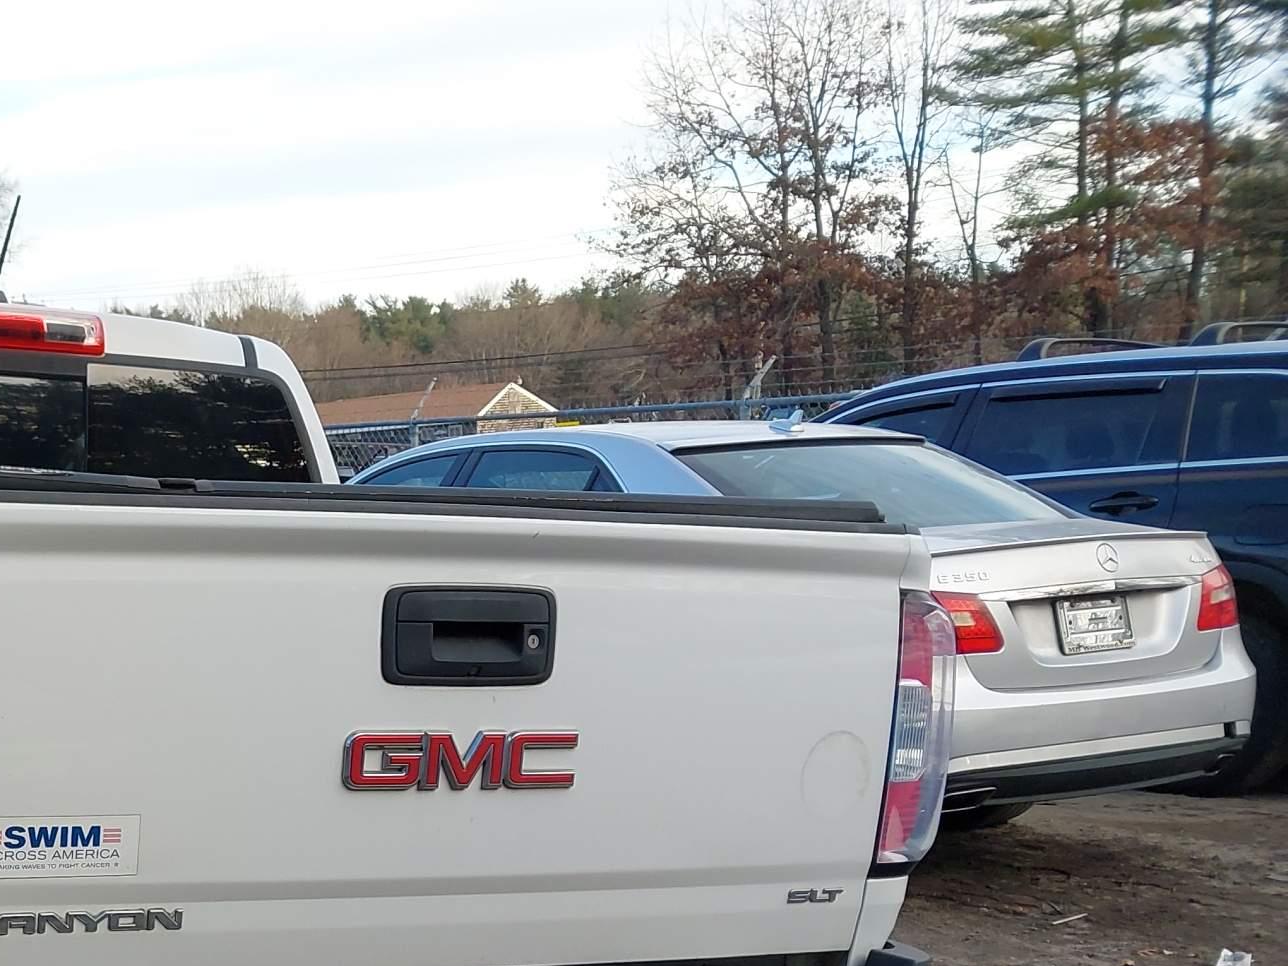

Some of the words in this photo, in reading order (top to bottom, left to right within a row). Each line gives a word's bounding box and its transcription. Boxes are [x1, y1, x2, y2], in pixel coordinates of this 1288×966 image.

[342, 730, 579, 791] GMC
[3, 825, 102, 850] SWIM
[51, 848, 120, 861] AMERICA
[787, 887, 844, 904] SLT
